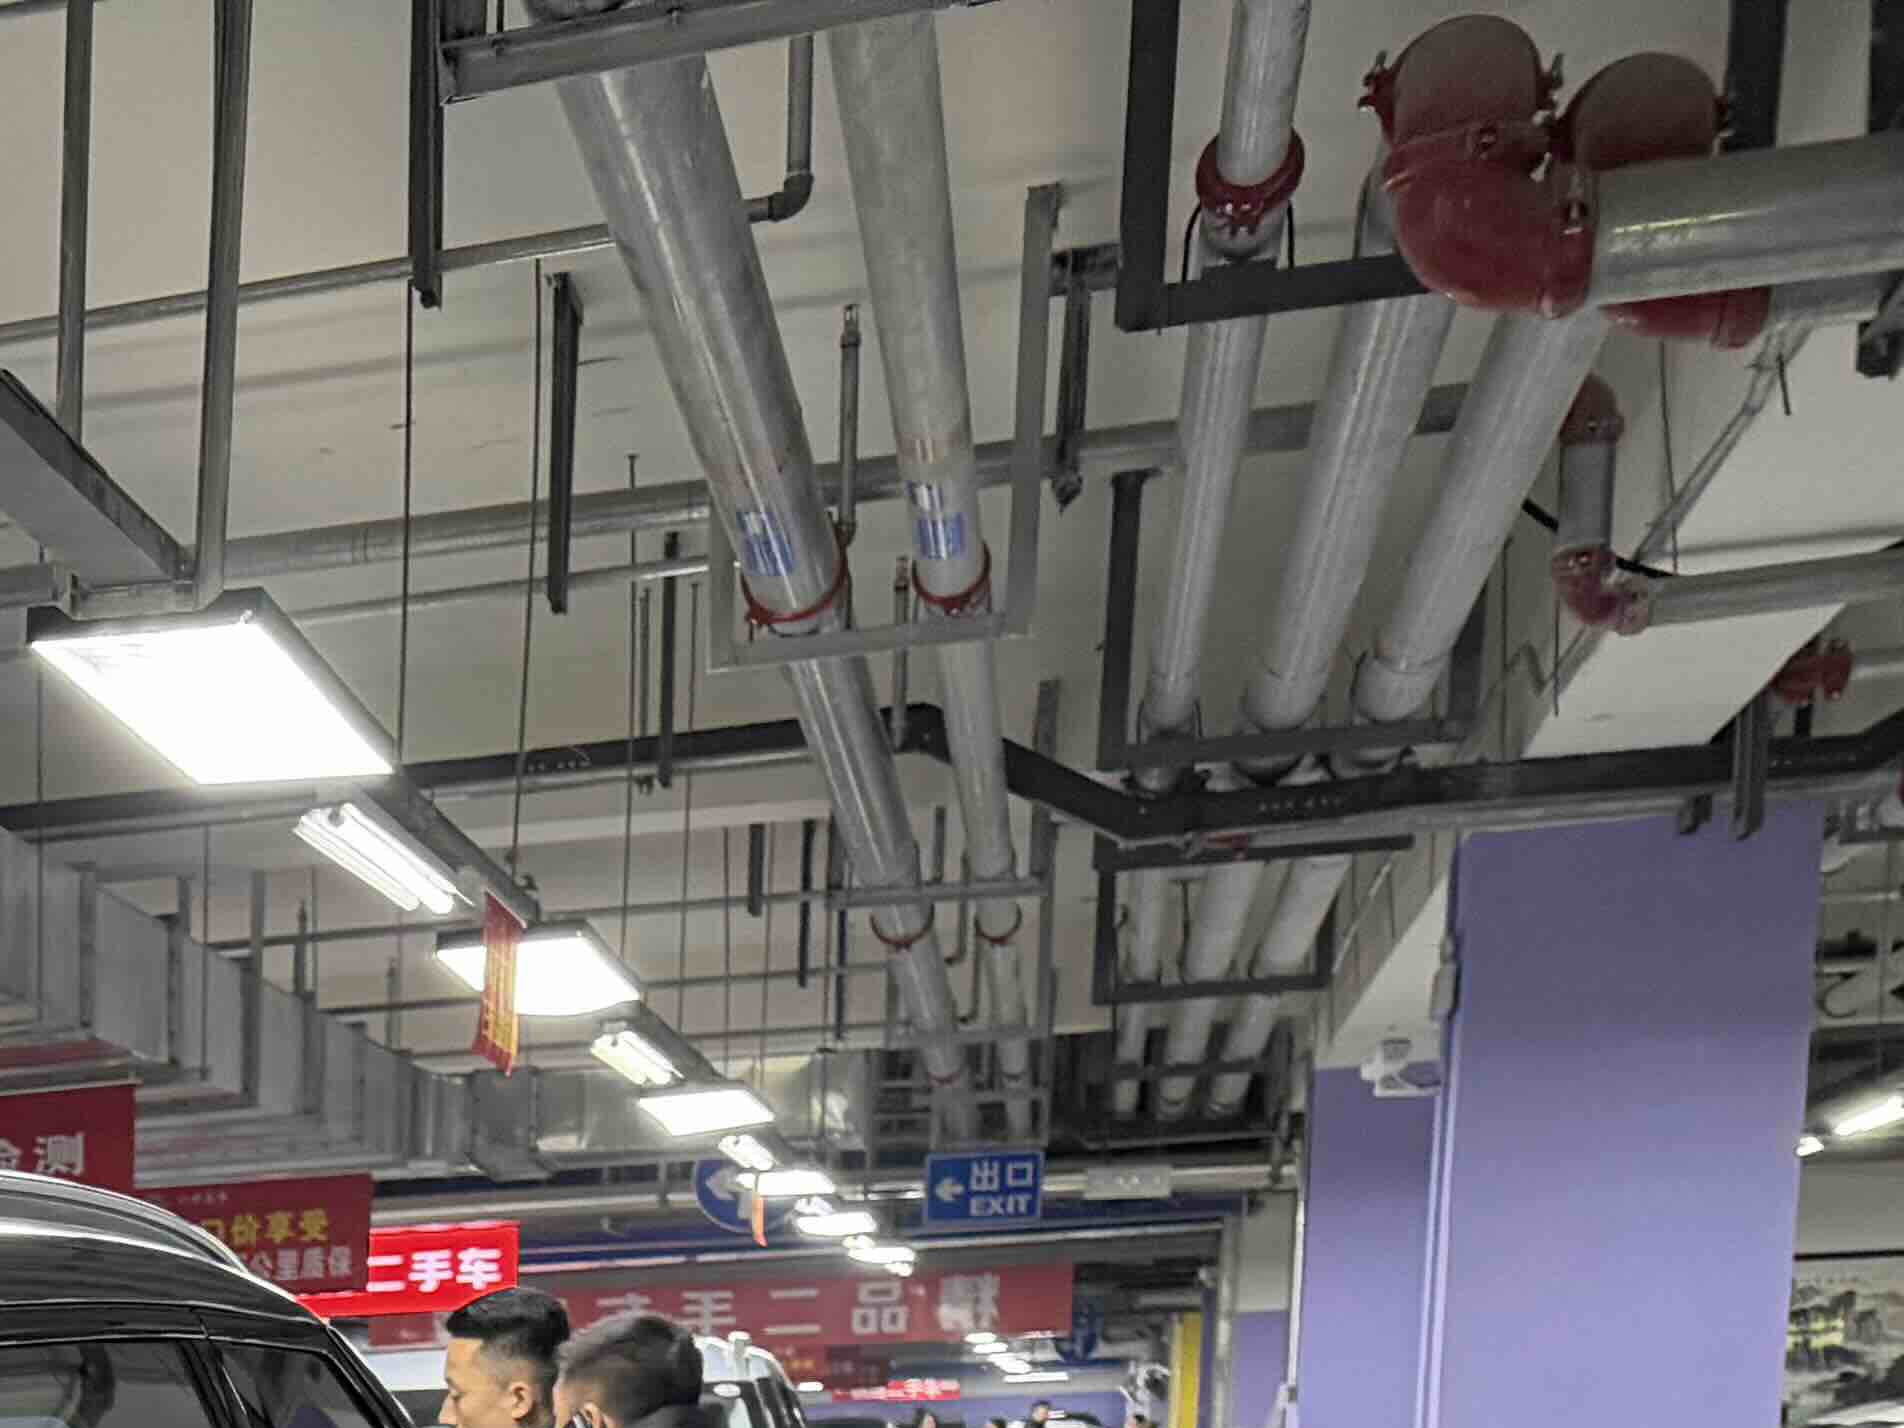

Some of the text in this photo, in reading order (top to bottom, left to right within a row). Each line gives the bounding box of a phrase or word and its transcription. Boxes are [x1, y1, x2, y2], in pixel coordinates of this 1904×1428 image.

[969, 1160, 1034, 1192] 出口
[969, 1195, 1031, 1217] EXIT
[366, 1247, 504, 1292] 二手车
